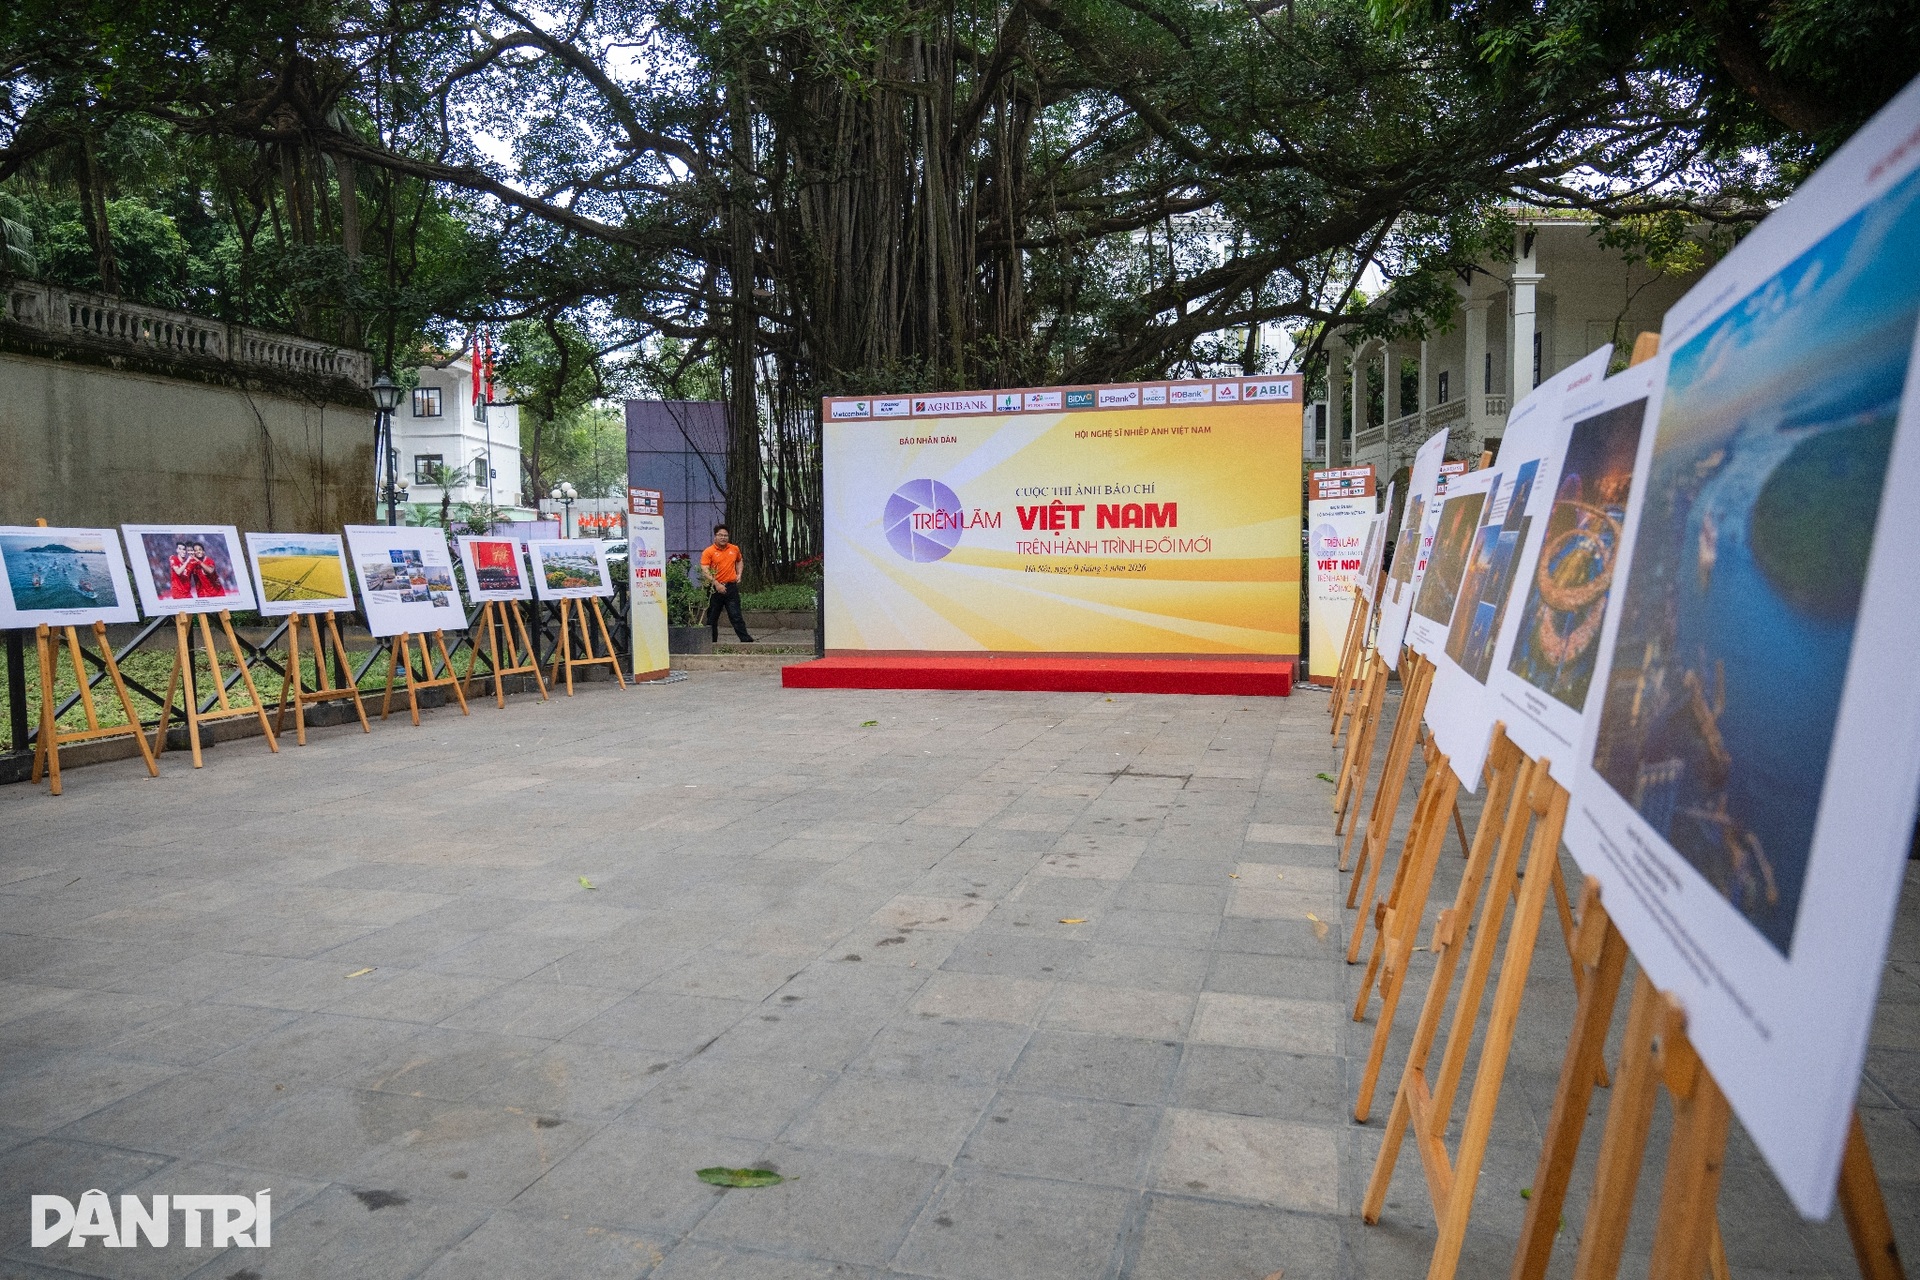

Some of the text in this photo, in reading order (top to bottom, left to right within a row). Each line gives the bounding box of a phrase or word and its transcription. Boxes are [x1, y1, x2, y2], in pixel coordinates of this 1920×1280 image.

[1171, 390, 1202, 398] HDBank
[1259, 384, 1289, 396] ABIC
[1068, 394, 1086, 403] BIDV
[1100, 395, 1129, 403] LPBank
[927, 400, 988, 412] AGRIBANK
[1075, 430, 1089, 439] HỘI
[1171, 425, 1189, 435] VIỆT
[1191, 426, 1211, 434] NAM
[900, 436, 915, 445] BÁO
[1015, 487, 1049, 498] CUỘC
[1051, 485, 1072, 496] THI
[1104, 483, 1131, 495] BÁO
[1133, 482, 1155, 494] CHÍ
[913, 508, 1001, 530] TRIỂN LÃM
[1015, 499, 1178, 537] VIỆT NAM
[1016, 534, 1212, 555] TRÊN HÀNH TRÌNH ĐỔI MỚI
[1128, 563, 1147, 572] 2026
[1317, 558, 1338, 572] VIỆT
